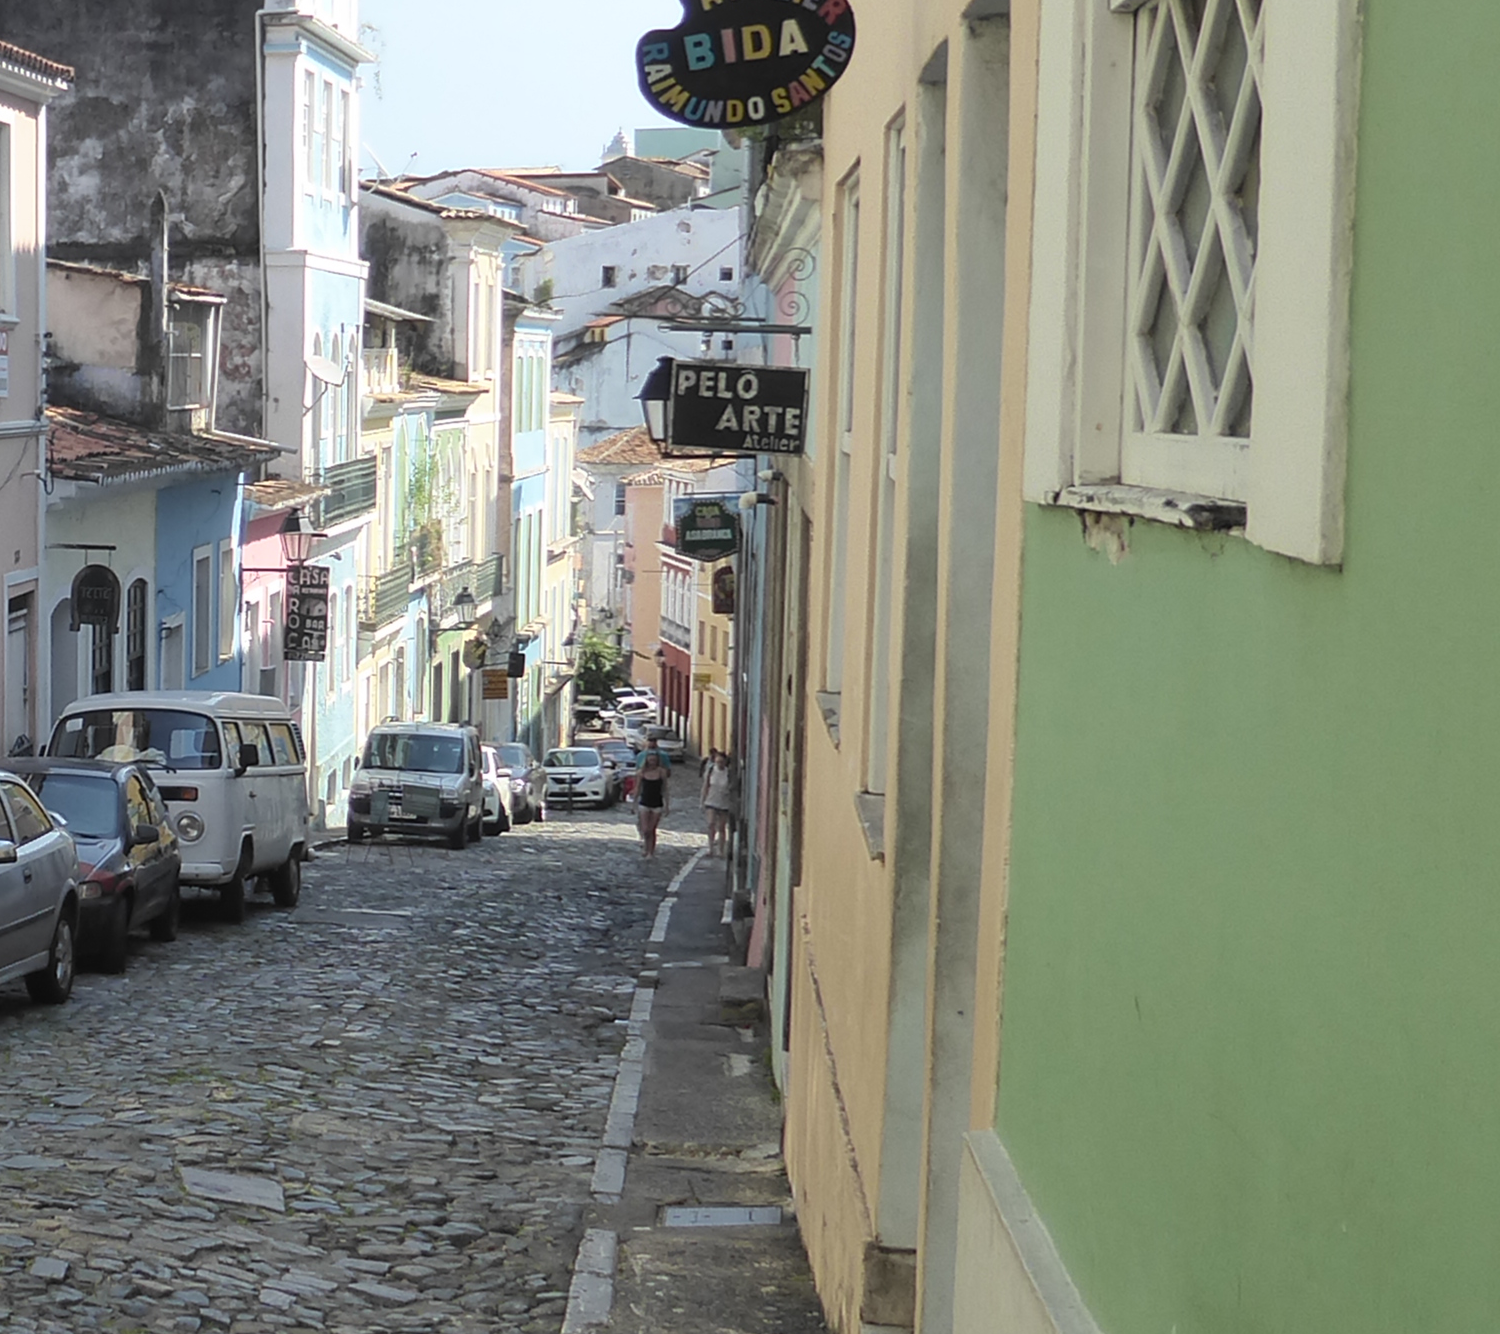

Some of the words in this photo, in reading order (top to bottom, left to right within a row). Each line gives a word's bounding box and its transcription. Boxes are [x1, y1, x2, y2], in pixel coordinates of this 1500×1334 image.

[683, 18, 809, 71] BIDA
[642, 41, 766, 124] RAIMUNDO
[770, 30, 852, 114] SANTOS
[676, 369, 759, 400] PELÔ
[714, 403, 800, 436] ARTE
[742, 433, 800, 451] Atelier
